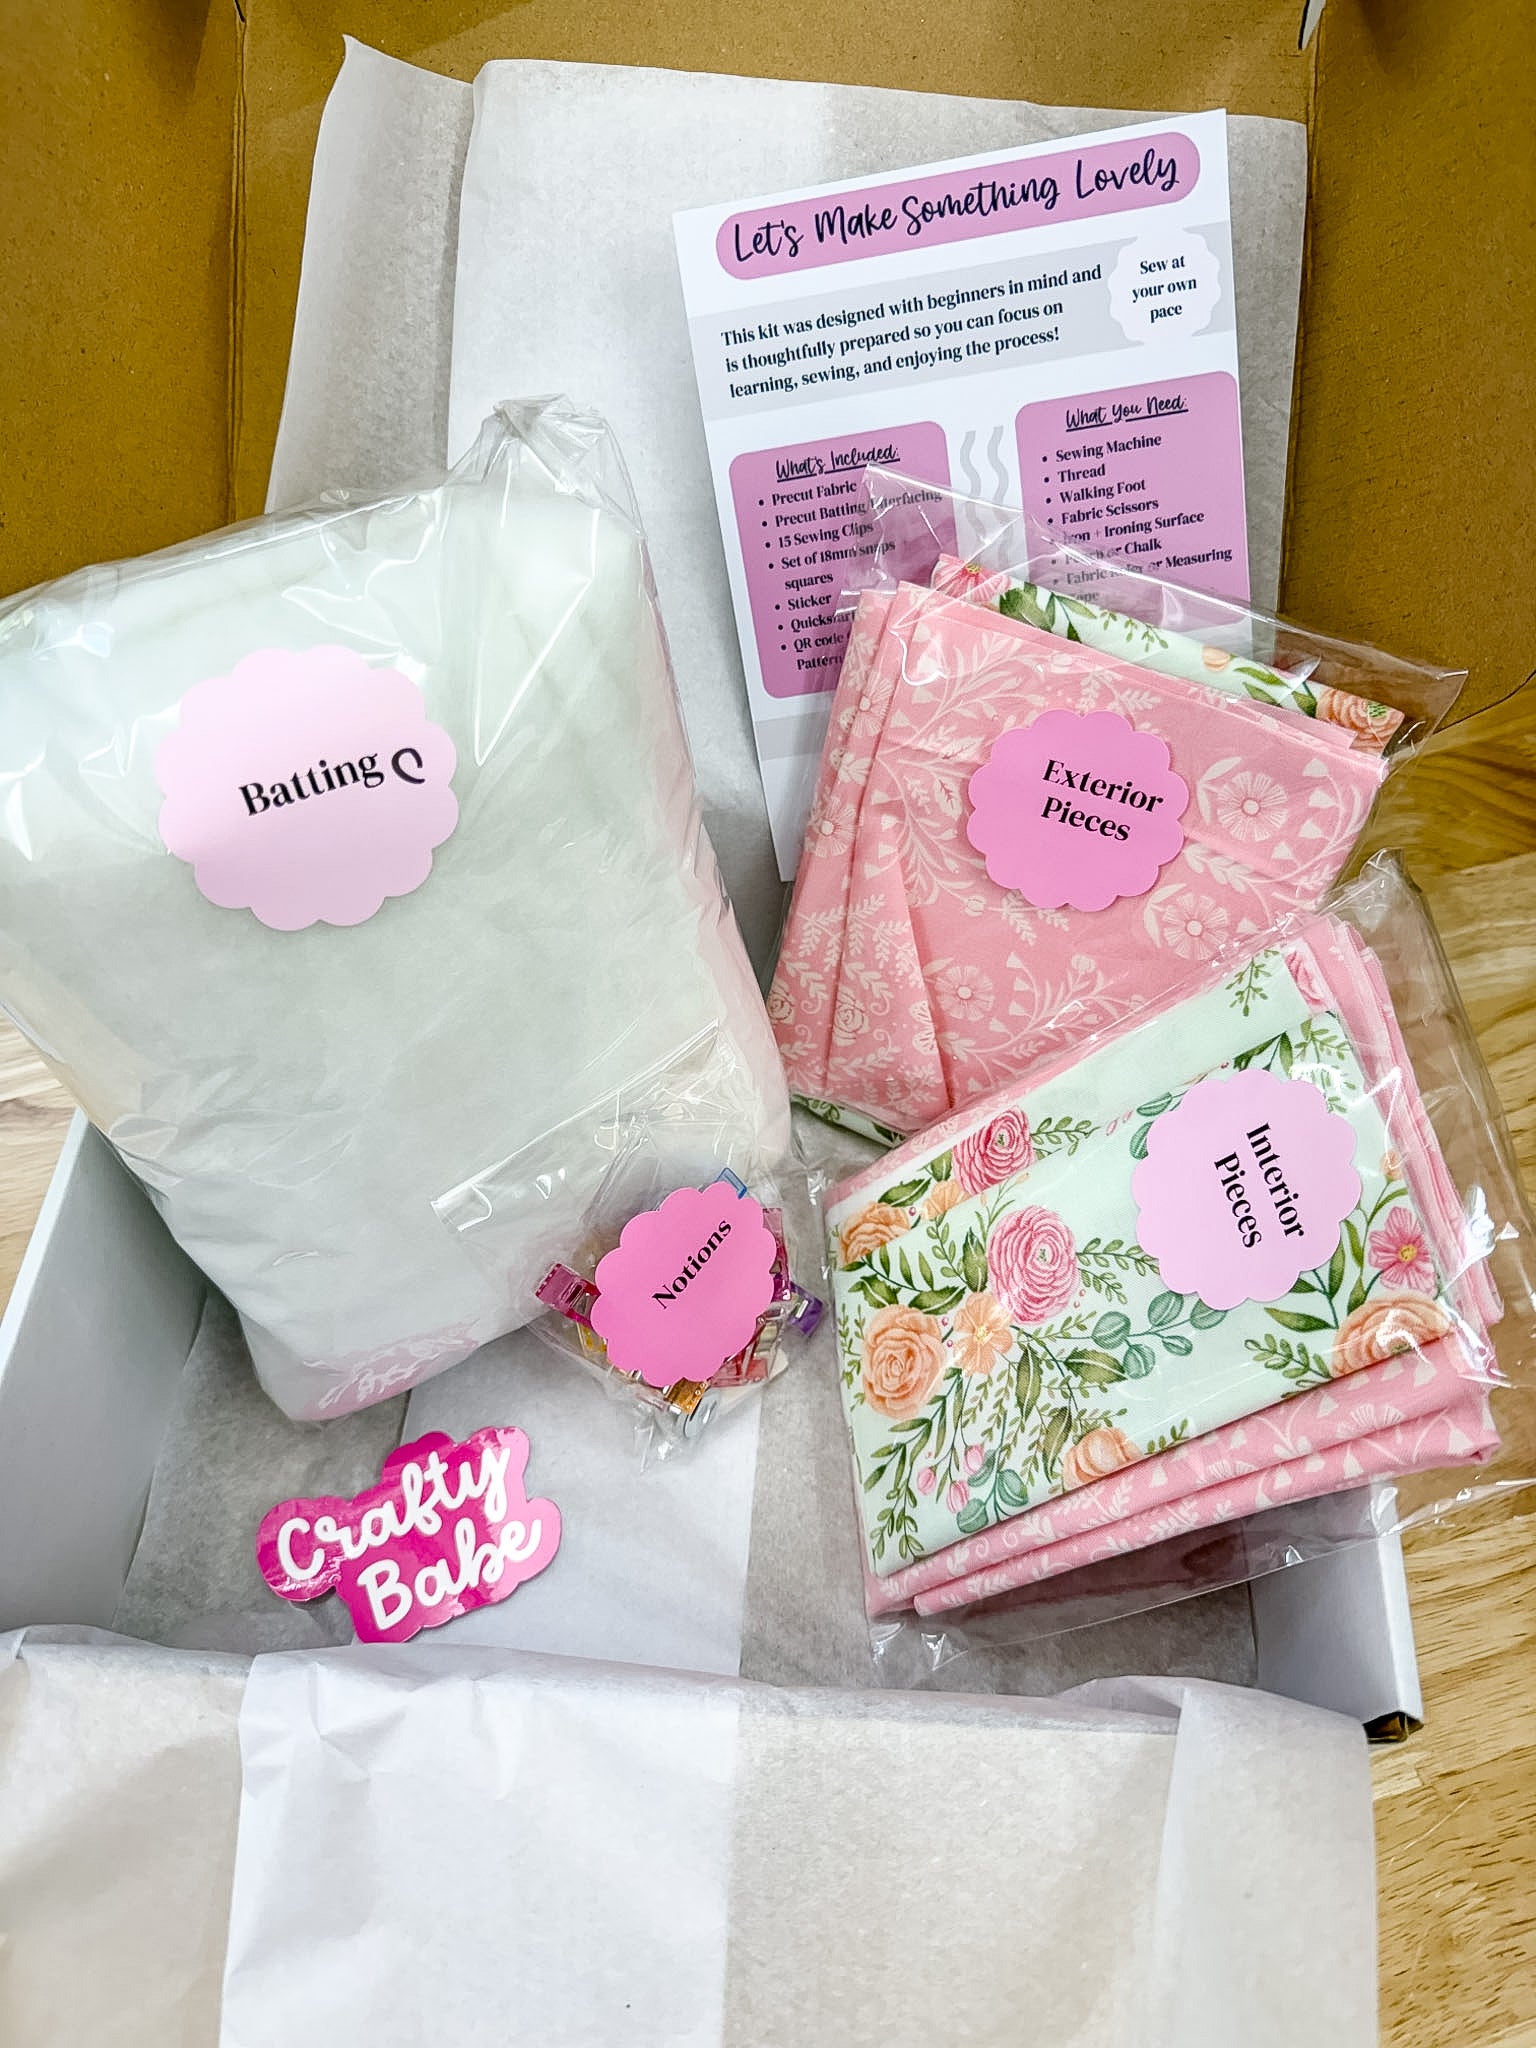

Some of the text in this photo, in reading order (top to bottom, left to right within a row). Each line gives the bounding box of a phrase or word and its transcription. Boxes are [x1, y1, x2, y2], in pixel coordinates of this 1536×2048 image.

[735, 148, 1180, 262] Let's Make Something Lovely
[1140, 255, 1185, 275] Sew at
[1132, 278, 1197, 303] your own
[721, 264, 1102, 347] This kit was designed with beginners in mind and
[1150, 304, 1183, 324] pace
[725, 302, 1064, 373] is thoughtfully prepared so you can focus on
[729, 326, 1060, 398] learning, sewing, and enjoying the process!
[1066, 407, 1107, 429] What
[1111, 403, 1142, 423] You
[1056, 434, 1162, 463] Sewing Machine
[776, 456, 826, 479] What's
[1057, 464, 1106, 483] Thread
[772, 481, 857, 506] Precut Fabric
[1059, 479, 1146, 504] Walking Foot
[775, 510, 816, 527] Precut
[820, 502, 867, 520] Batting
[1061, 499, 1159, 525] Fabric Scissors
[1104, 521, 1152, 538] Ironing
[1154, 511, 1205, 530] Surface
[779, 522, 874, 548] 15 Sewing Clips
[1124, 538, 1162, 555] Chalk
[781, 555, 802, 569] Set
[804, 551, 818, 565] of
[820, 548, 858, 563] 18mm
[1066, 569, 1107, 585] Fabric
[1165, 547, 1233, 569] Measuring
[785, 574, 834, 591] squares
[788, 594, 832, 611] Sticker
[794, 637, 812, 652] QR
[238, 753, 385, 816] Batting
[1043, 759, 1164, 812] Exterior
[1041, 796, 1131, 841] Pieces
[1246, 1122, 1305, 1237] Interior
[1214, 1151, 1262, 1248] Pieces
[652, 1220, 732, 1309] Notions
[277, 1448, 511, 1581] Crafty
[357, 1517, 542, 1631] Babe
